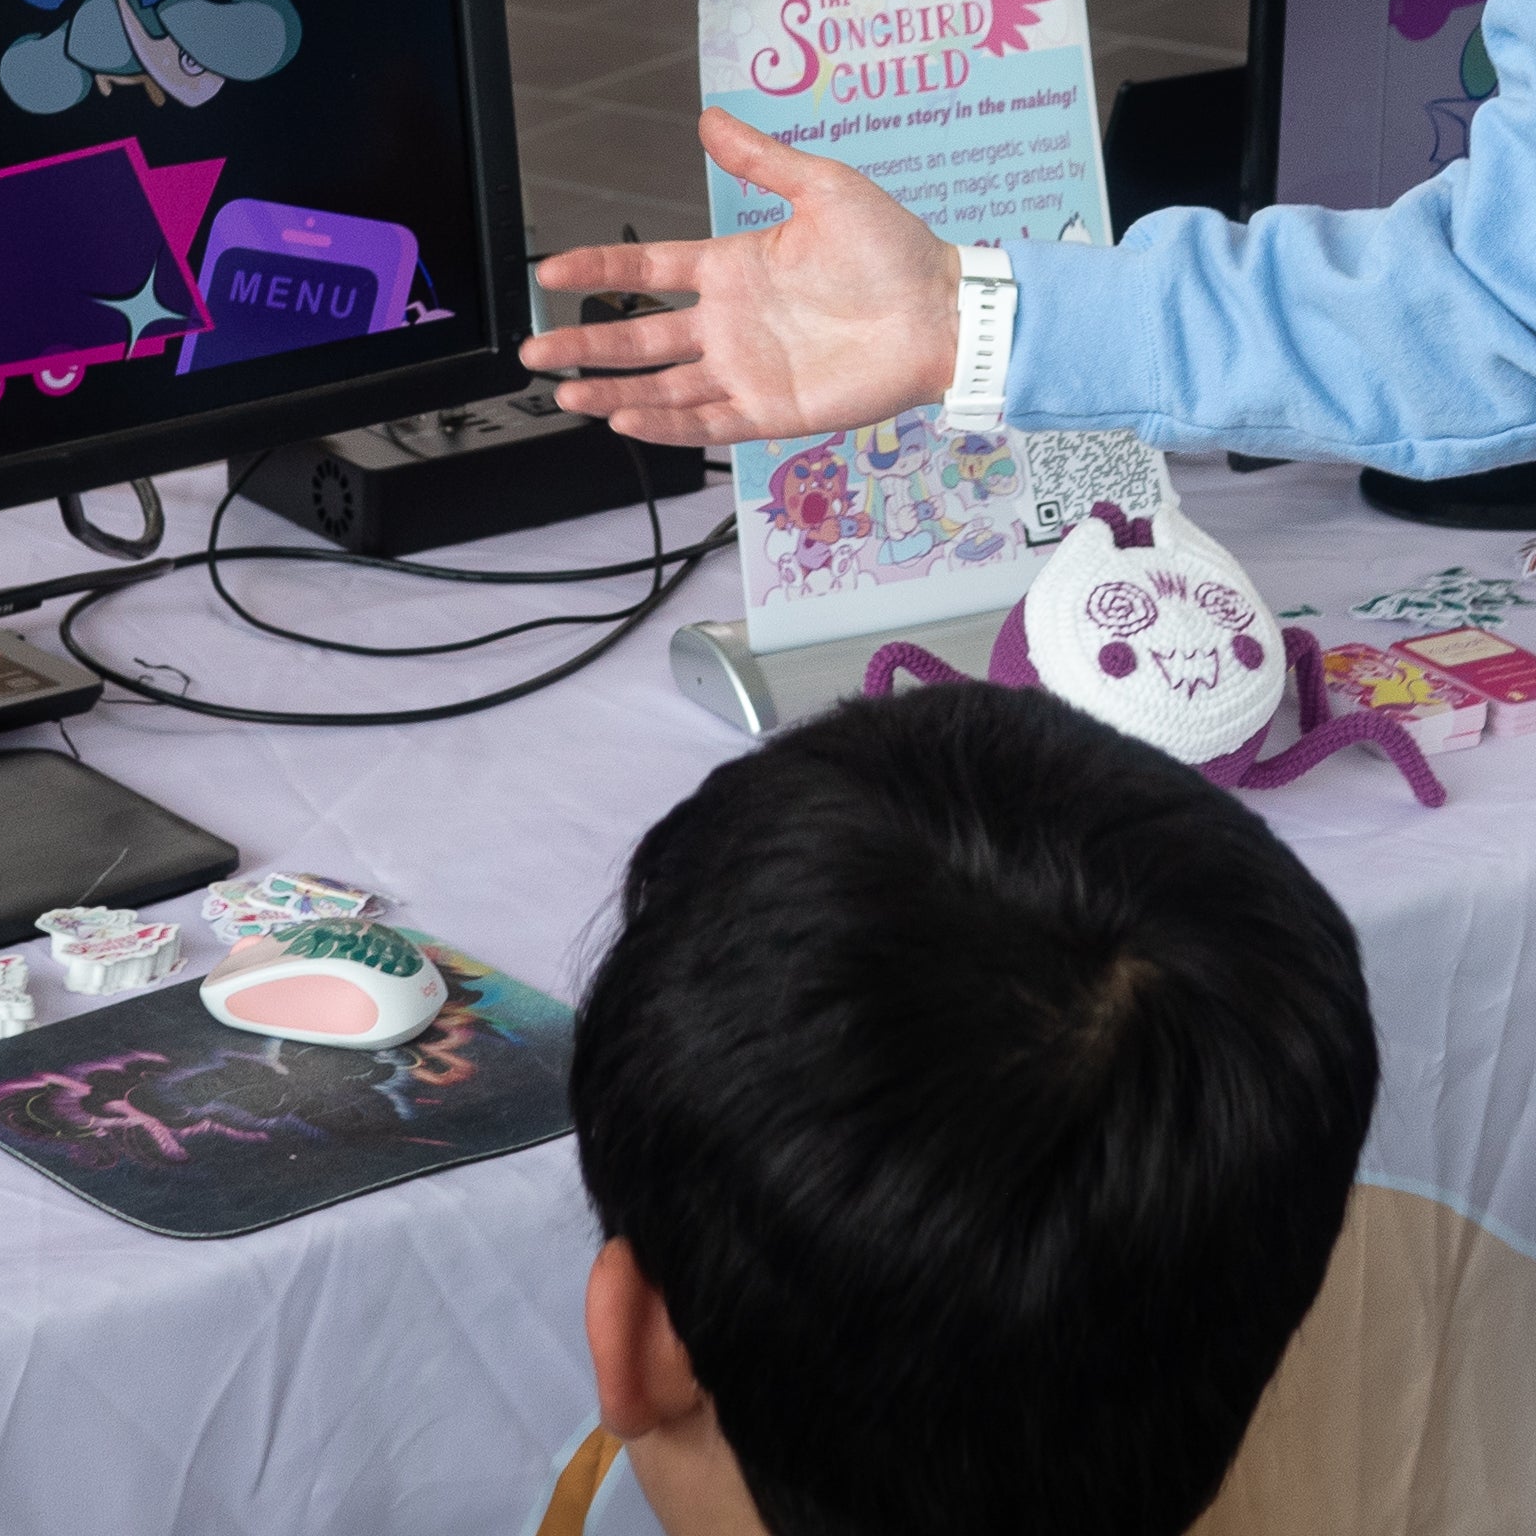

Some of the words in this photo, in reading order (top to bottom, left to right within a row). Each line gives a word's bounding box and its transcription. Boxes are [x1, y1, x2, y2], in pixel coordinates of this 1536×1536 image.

[831, 49, 970, 104] GUILD
[769, 119, 825, 146] agical
[830, 118, 861, 142] girl
[866, 113, 901, 132] love
[907, 106, 952, 127] story
[955, 101, 972, 119] in
[978, 96, 1005, 116] the
[1010, 86, 1078, 112] making!
[927, 152, 946, 169] an
[950, 140, 1025, 165] energetic
[1029, 131, 1071, 153] visual
[888, 182, 948, 202] aturing
[953, 170, 1000, 195] magic
[1005, 163, 1064, 190] granted
[1067, 158, 1086, 180] by
[737, 201, 784, 226] novel
[955, 202, 986, 223] way
[990, 196, 1015, 216] too
[1021, 191, 1063, 214] many
[230, 270, 357, 319] MENU
